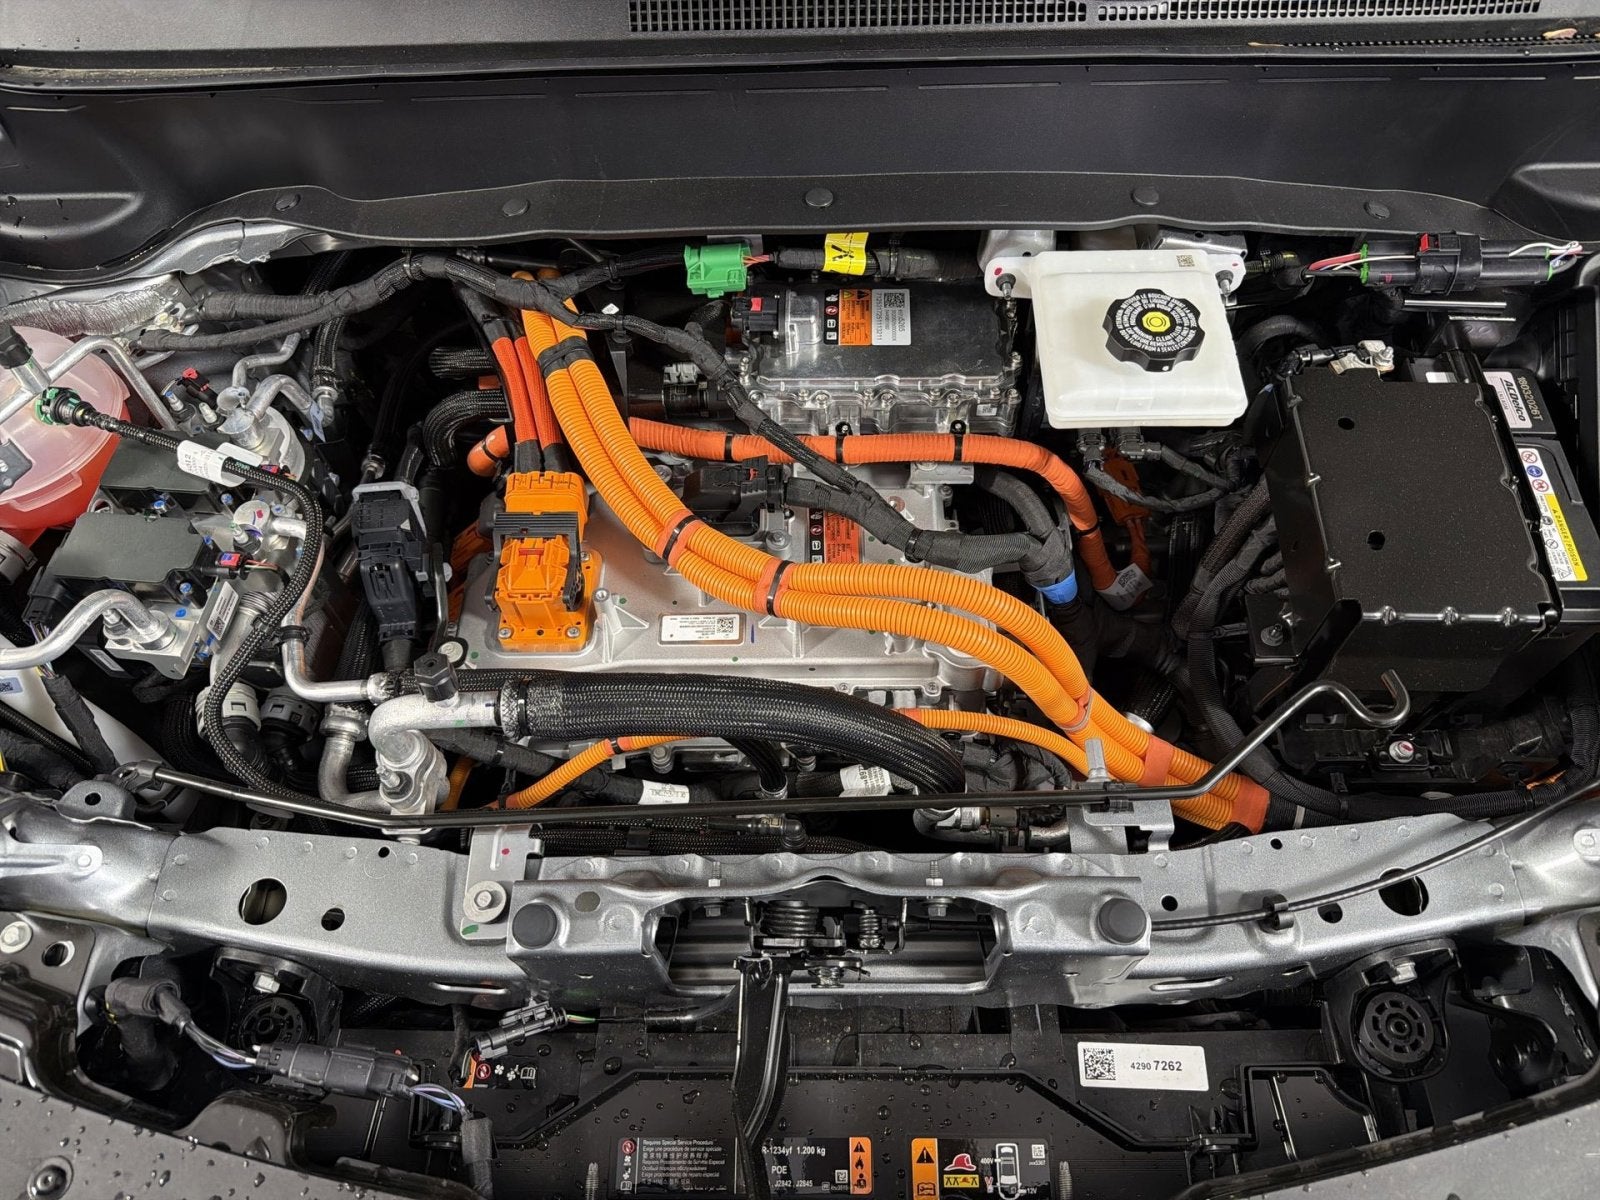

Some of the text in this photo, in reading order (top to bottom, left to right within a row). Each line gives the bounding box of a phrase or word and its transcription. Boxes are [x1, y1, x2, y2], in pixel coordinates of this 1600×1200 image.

[1504, 380, 1526, 422] ACDelco
[1130, 1061, 1182, 1071] 4290 7262
[762, 1146, 826, 1157] R-1234yf 1.200 kg
[772, 1166, 787, 1174] POE
